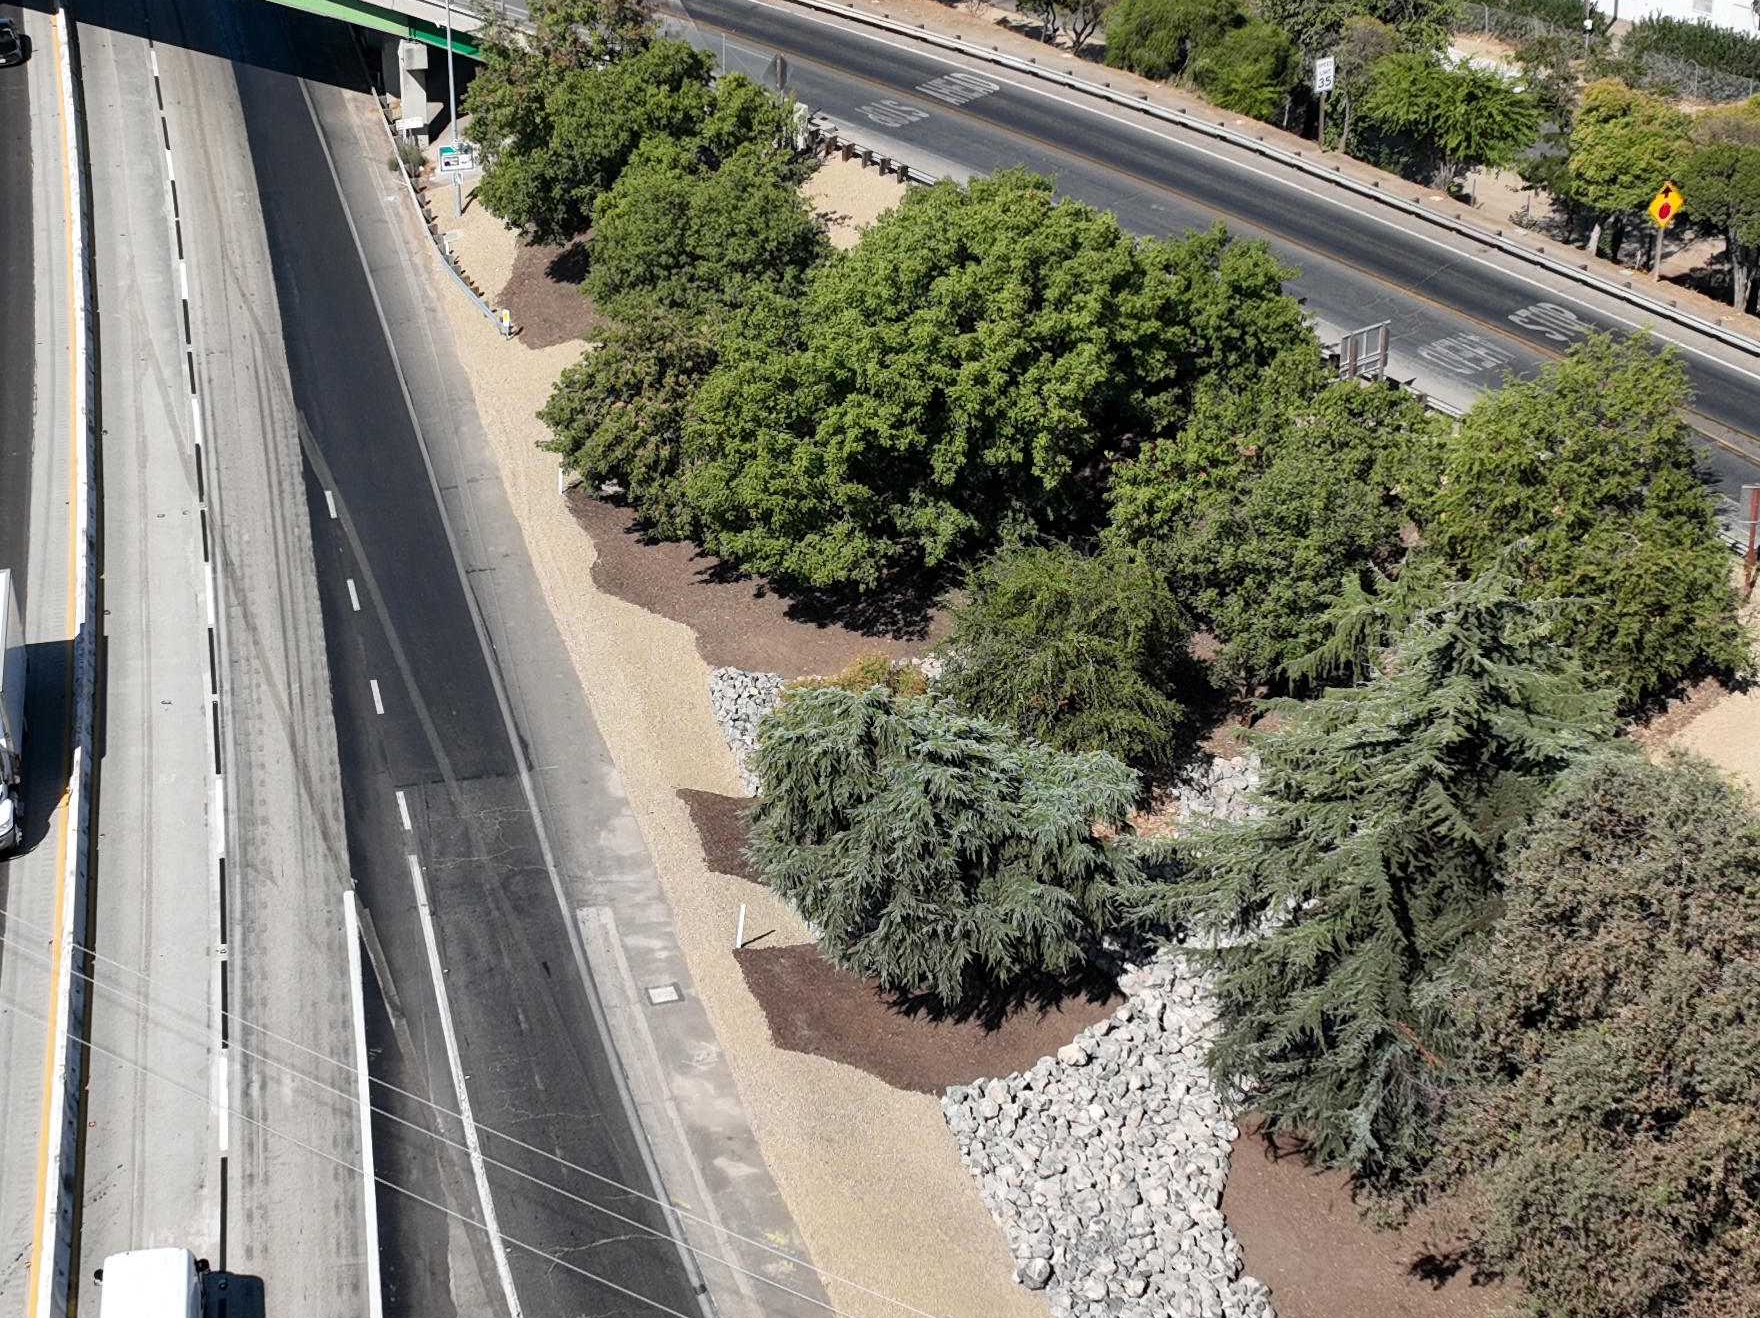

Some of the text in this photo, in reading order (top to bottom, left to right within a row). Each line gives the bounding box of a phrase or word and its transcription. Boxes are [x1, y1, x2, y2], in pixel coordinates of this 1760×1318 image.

[915, 72, 1001, 106] AHEAD
[1318, 76, 1332, 89] 35
[855, 99, 930, 128] STOP
[1508, 302, 1597, 341] STOP
[1417, 332, 1517, 375] AHEAD
